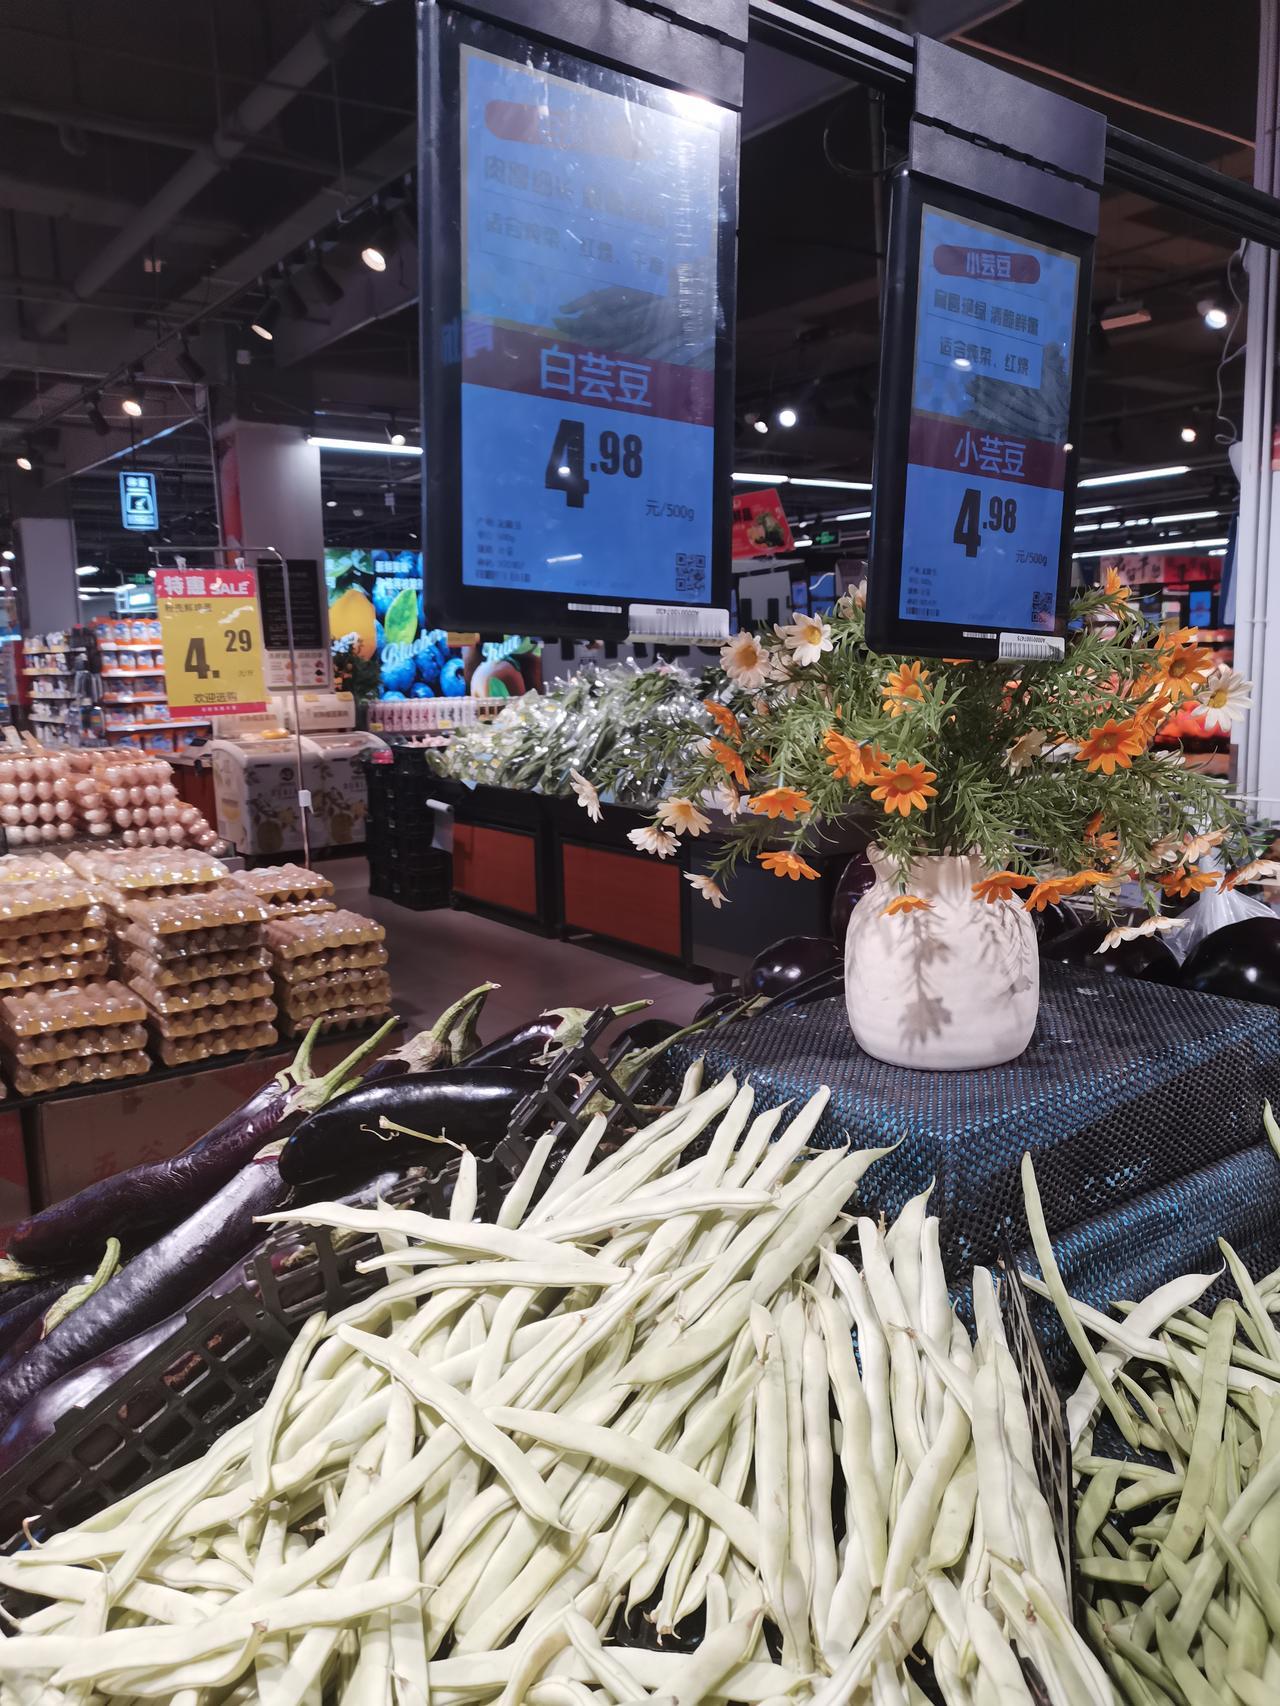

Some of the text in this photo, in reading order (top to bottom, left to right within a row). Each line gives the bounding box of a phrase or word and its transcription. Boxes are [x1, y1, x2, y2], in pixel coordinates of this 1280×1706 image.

[966, 252, 1011, 278] 小芸豆
[540, 343, 652, 407] 白芸豆
[545, 419, 642, 508] 4.98
[954, 431, 1026, 477] 小芸豆
[645, 500, 695, 521] 元/500g
[953, 488, 1017, 558] 4.98
[1016, 550, 1048, 566] 元/500g
[163, 576, 250, 596] 特惠 SALE
